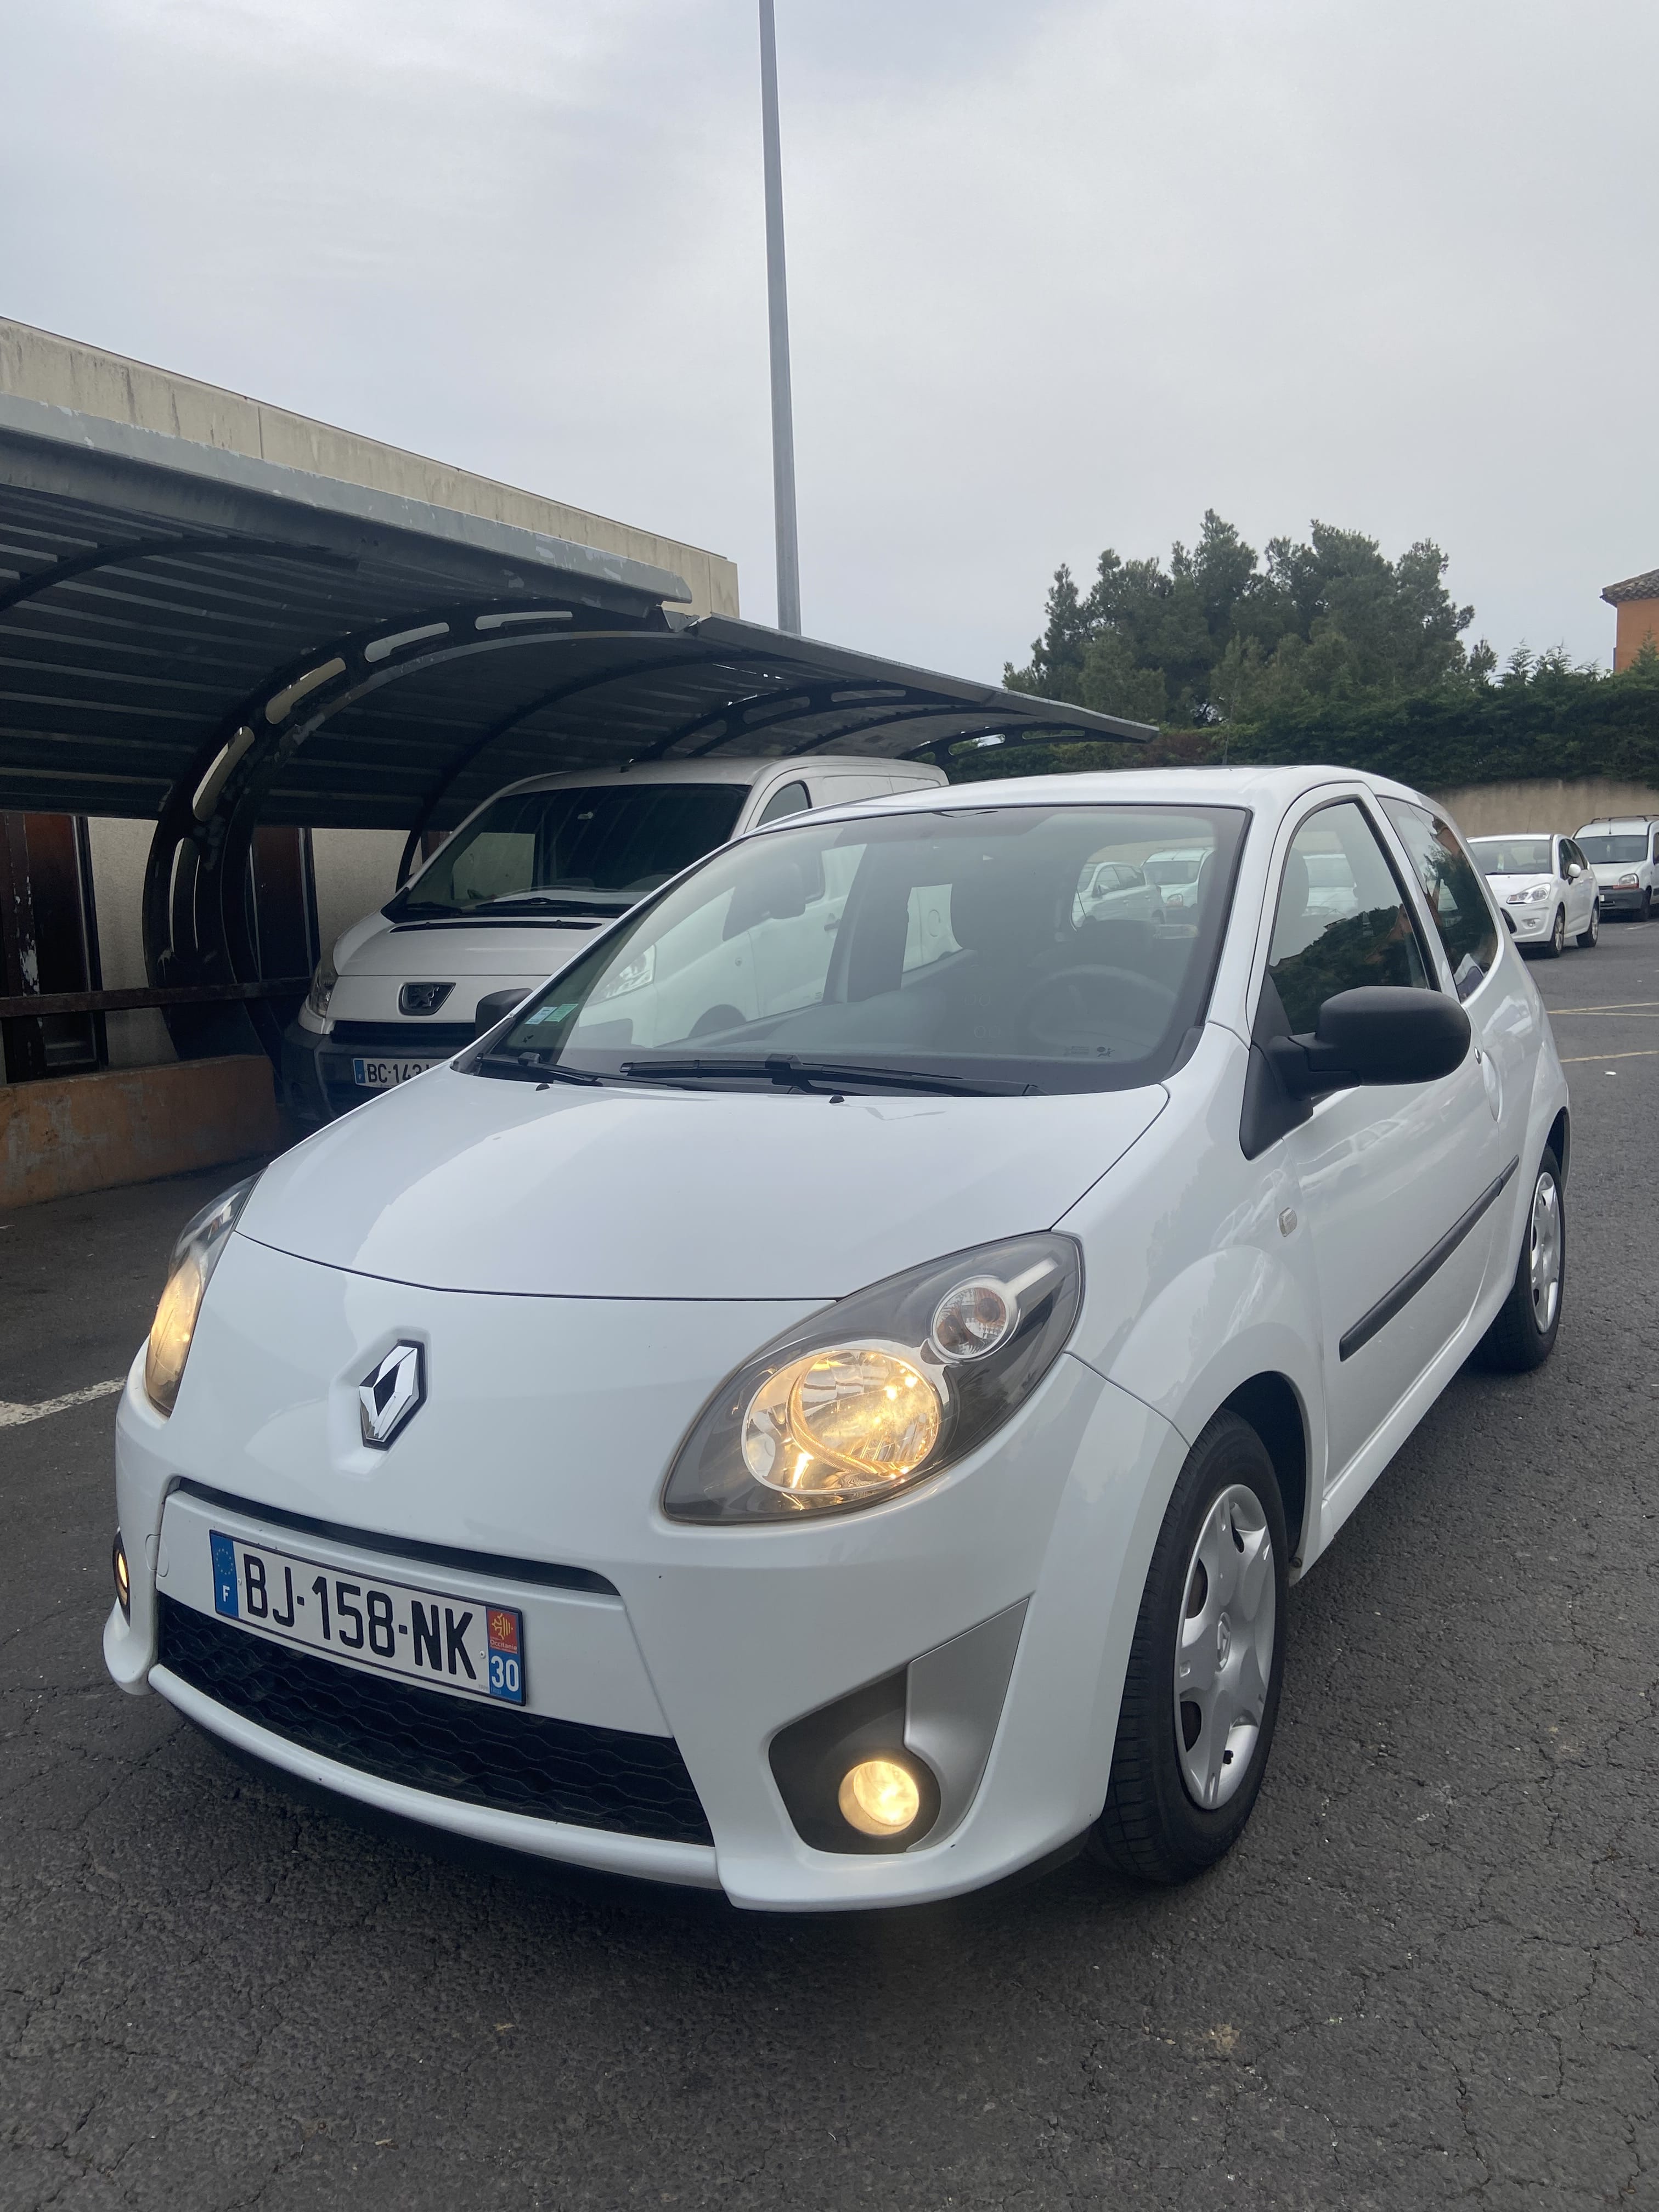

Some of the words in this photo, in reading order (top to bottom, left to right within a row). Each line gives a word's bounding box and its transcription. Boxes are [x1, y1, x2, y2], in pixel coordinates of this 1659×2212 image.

[367, 1063, 430, 1084] BC-143
[222, 1585, 230, 1602] F
[243, 1553, 477, 1680] BJ-158-NK
[490, 1639, 517, 1651] Occitanie
[491, 1655, 519, 1692] 30
